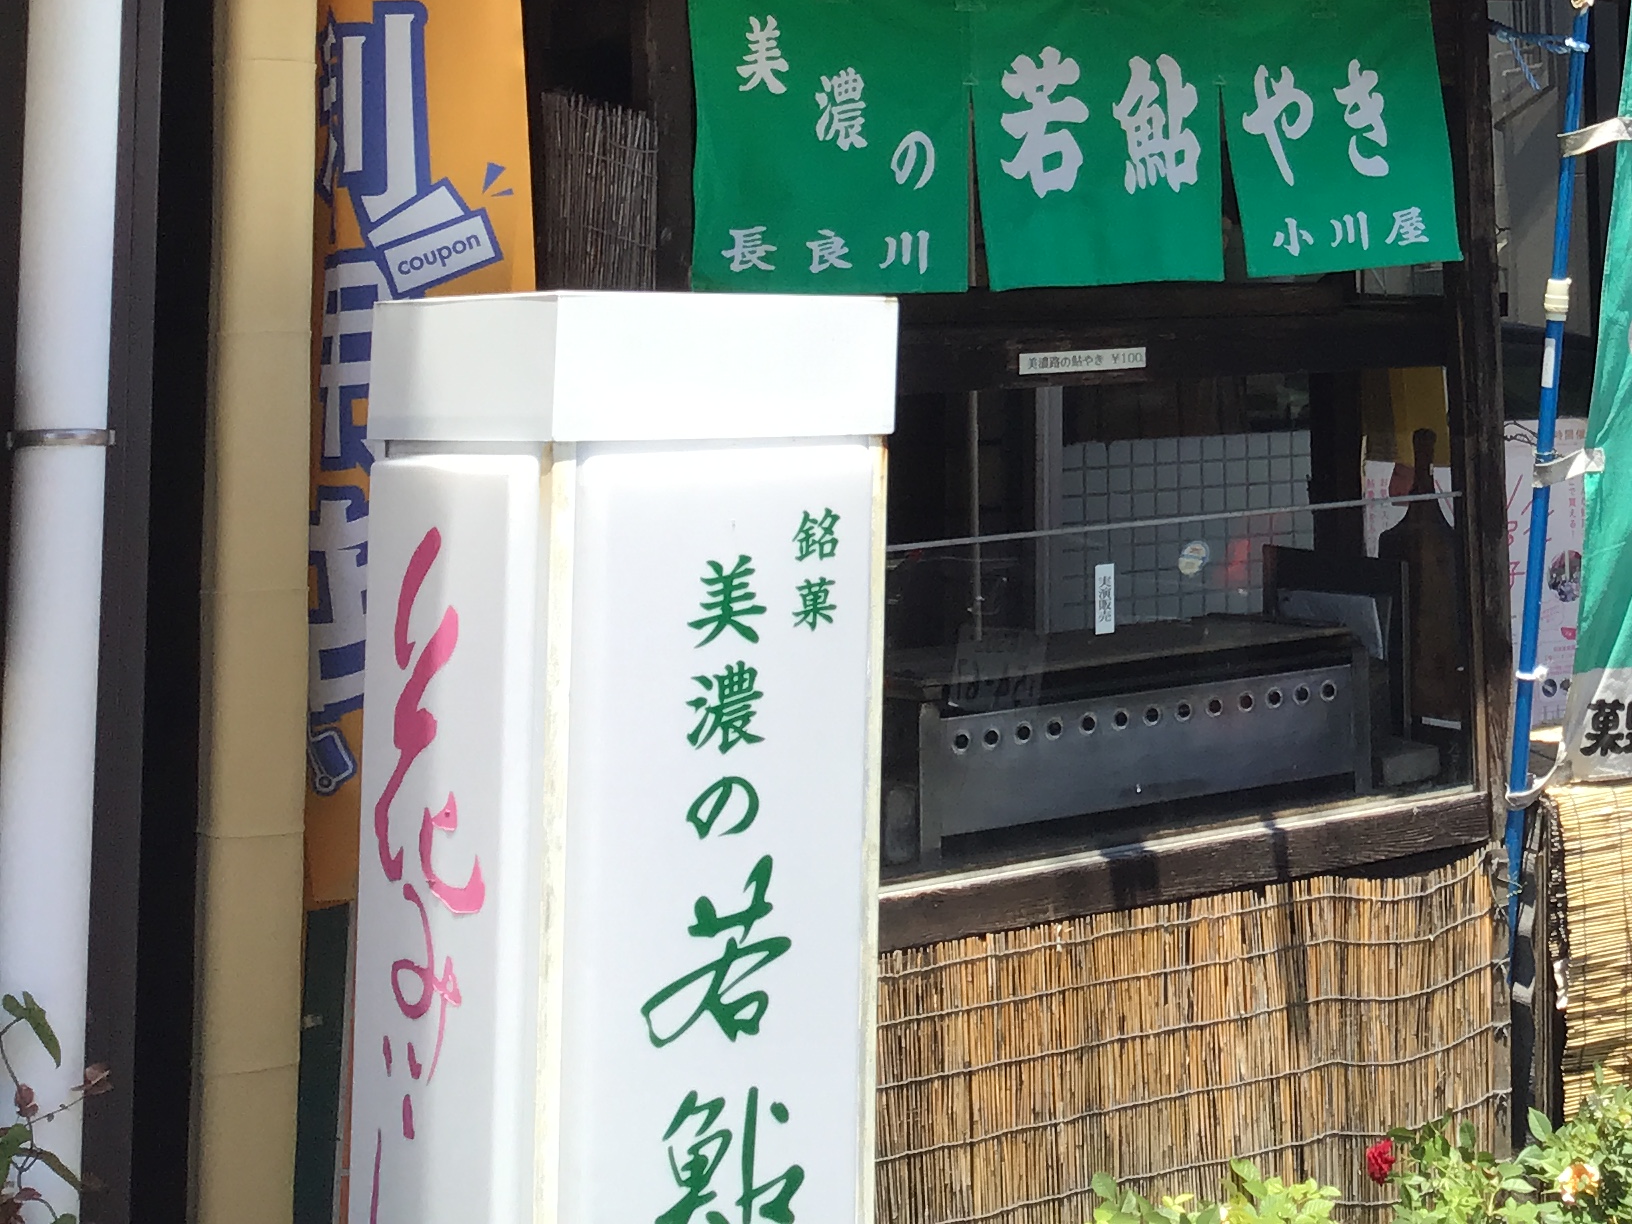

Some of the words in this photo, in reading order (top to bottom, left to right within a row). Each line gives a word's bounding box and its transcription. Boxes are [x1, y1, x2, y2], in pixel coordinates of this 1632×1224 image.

[736, 14, 936, 190] 美濃の
[397, 232, 482, 276] coupon
[721, 225, 930, 274] 長良川
[1273, 206, 1431, 257] 小川屋
[791, 506, 841, 632] 銘菓
